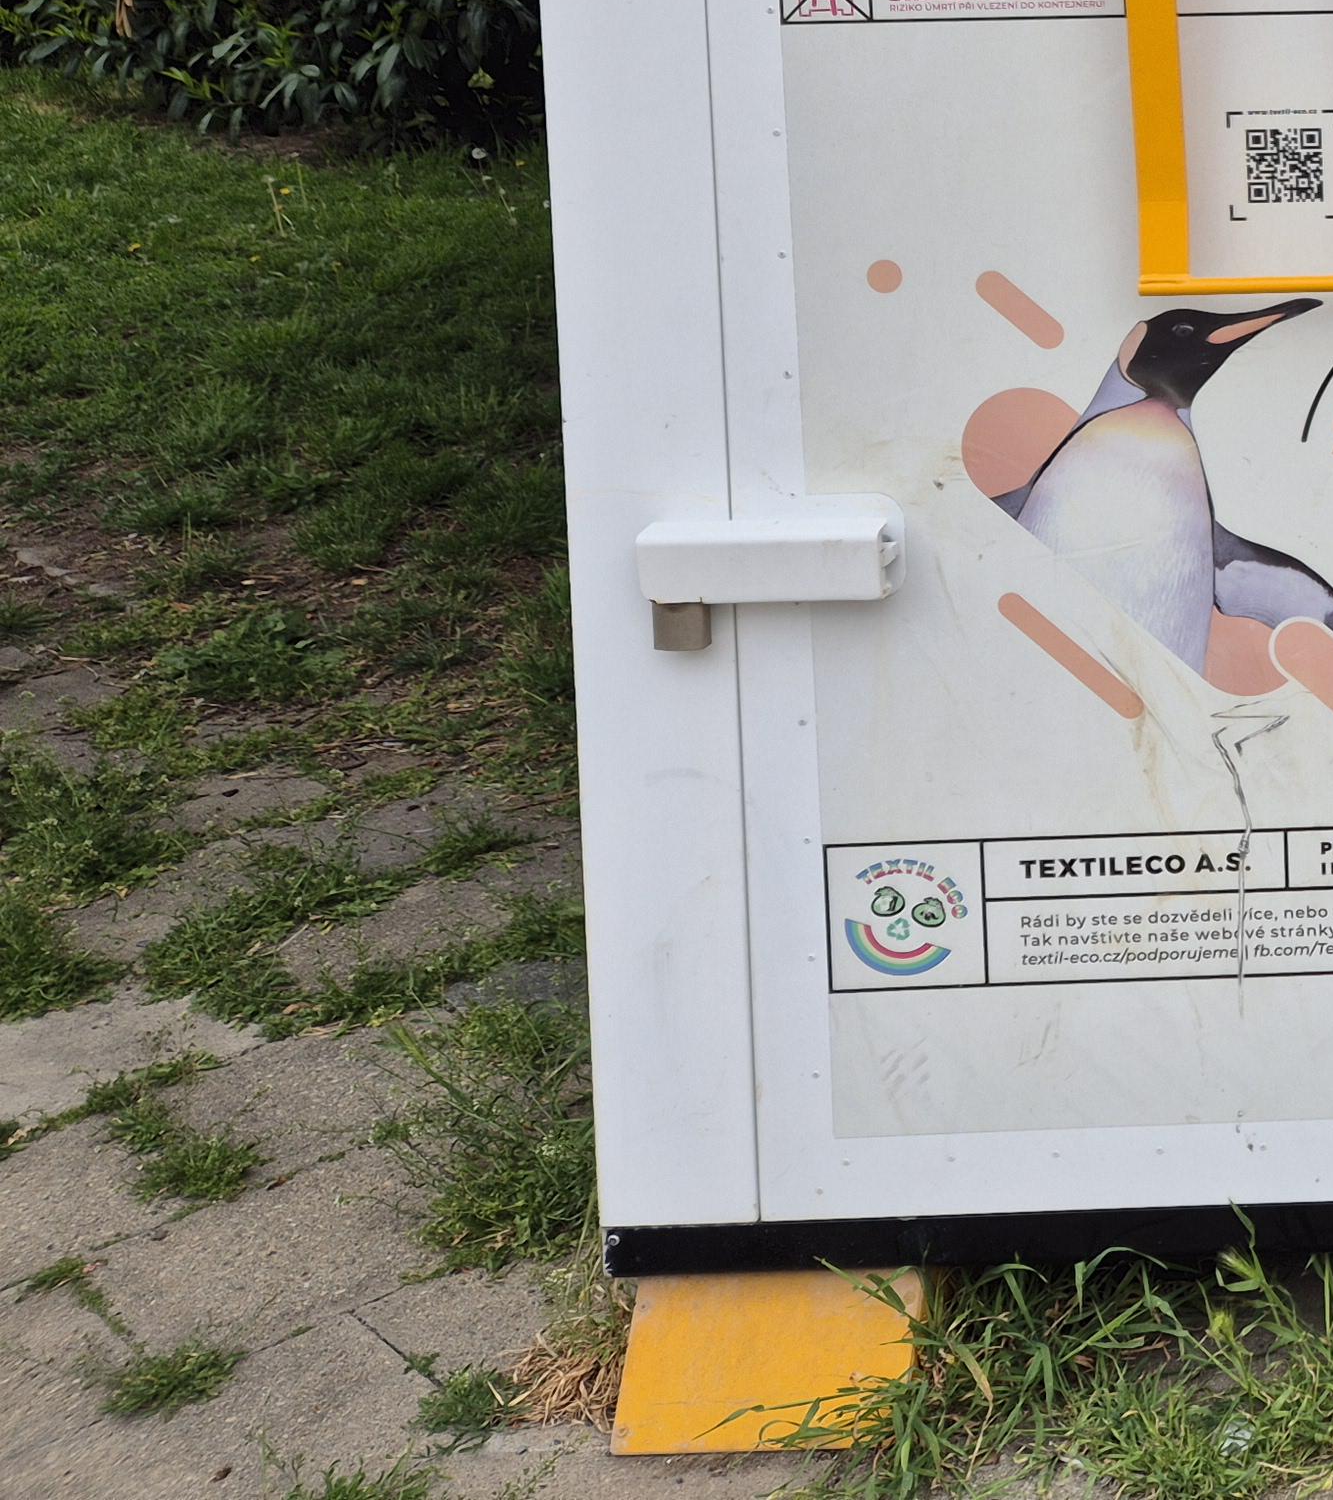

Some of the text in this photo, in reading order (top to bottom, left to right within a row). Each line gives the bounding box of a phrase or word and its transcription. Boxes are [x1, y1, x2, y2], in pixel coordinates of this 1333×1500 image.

[889, 3, 923, 12] RIZIKO
[976, 0, 1019, 10] VLEZENÍ
[855, 858, 935, 885] TEXTIL
[1019, 852, 1251, 879] TEXTILECO A.S.
[1320, 861, 1327, 875] I
[1020, 914, 1059, 929] Rádi
[1065, 913, 1087, 929] by
[1091, 914, 1118, 926] ste
[1123, 914, 1143, 925] se
[1147, 908, 1233, 924] dozvědeli
[1283, 905, 1328, 919] nebo
[1020, 933, 1053, 947] Tak
[1058, 930, 1142, 946] navštivte
[1147, 928, 1190, 943] naše
[1021, 945, 1239, 966] textil-eco.cz/podporujeme
